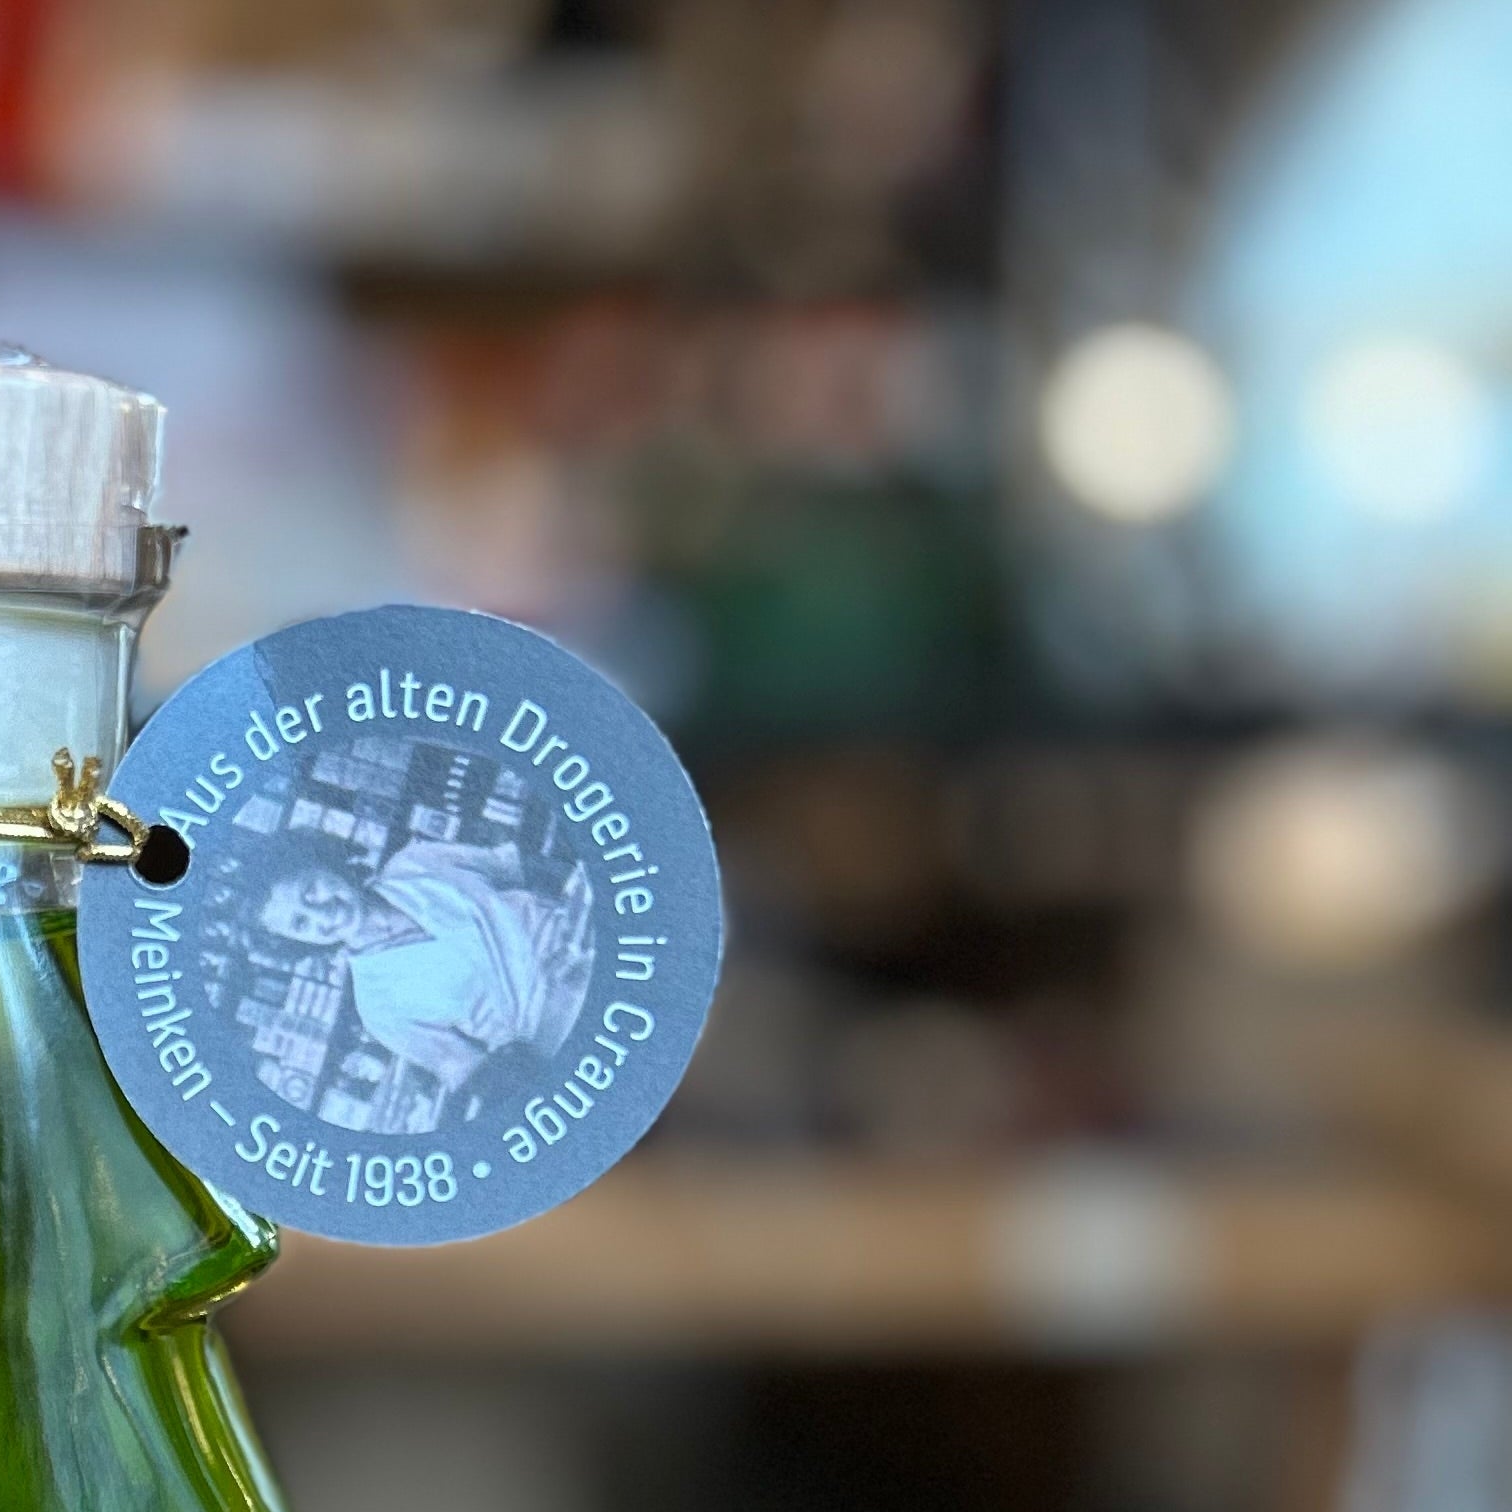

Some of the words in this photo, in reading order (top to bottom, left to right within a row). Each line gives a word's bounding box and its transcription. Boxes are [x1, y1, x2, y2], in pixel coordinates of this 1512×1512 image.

[245, 693, 324, 762] der
[346, 667, 489, 732] alten
[159, 752, 245, 850] Aus
[500, 699, 660, 915] Drogerie
[615, 935, 668, 982] in
[131, 898, 213, 1101] Meinken
[235, 1114, 334, 1196] Seit
[346, 1151, 459, 1207] 1938
[502, 1002, 655, 1163] Crange
